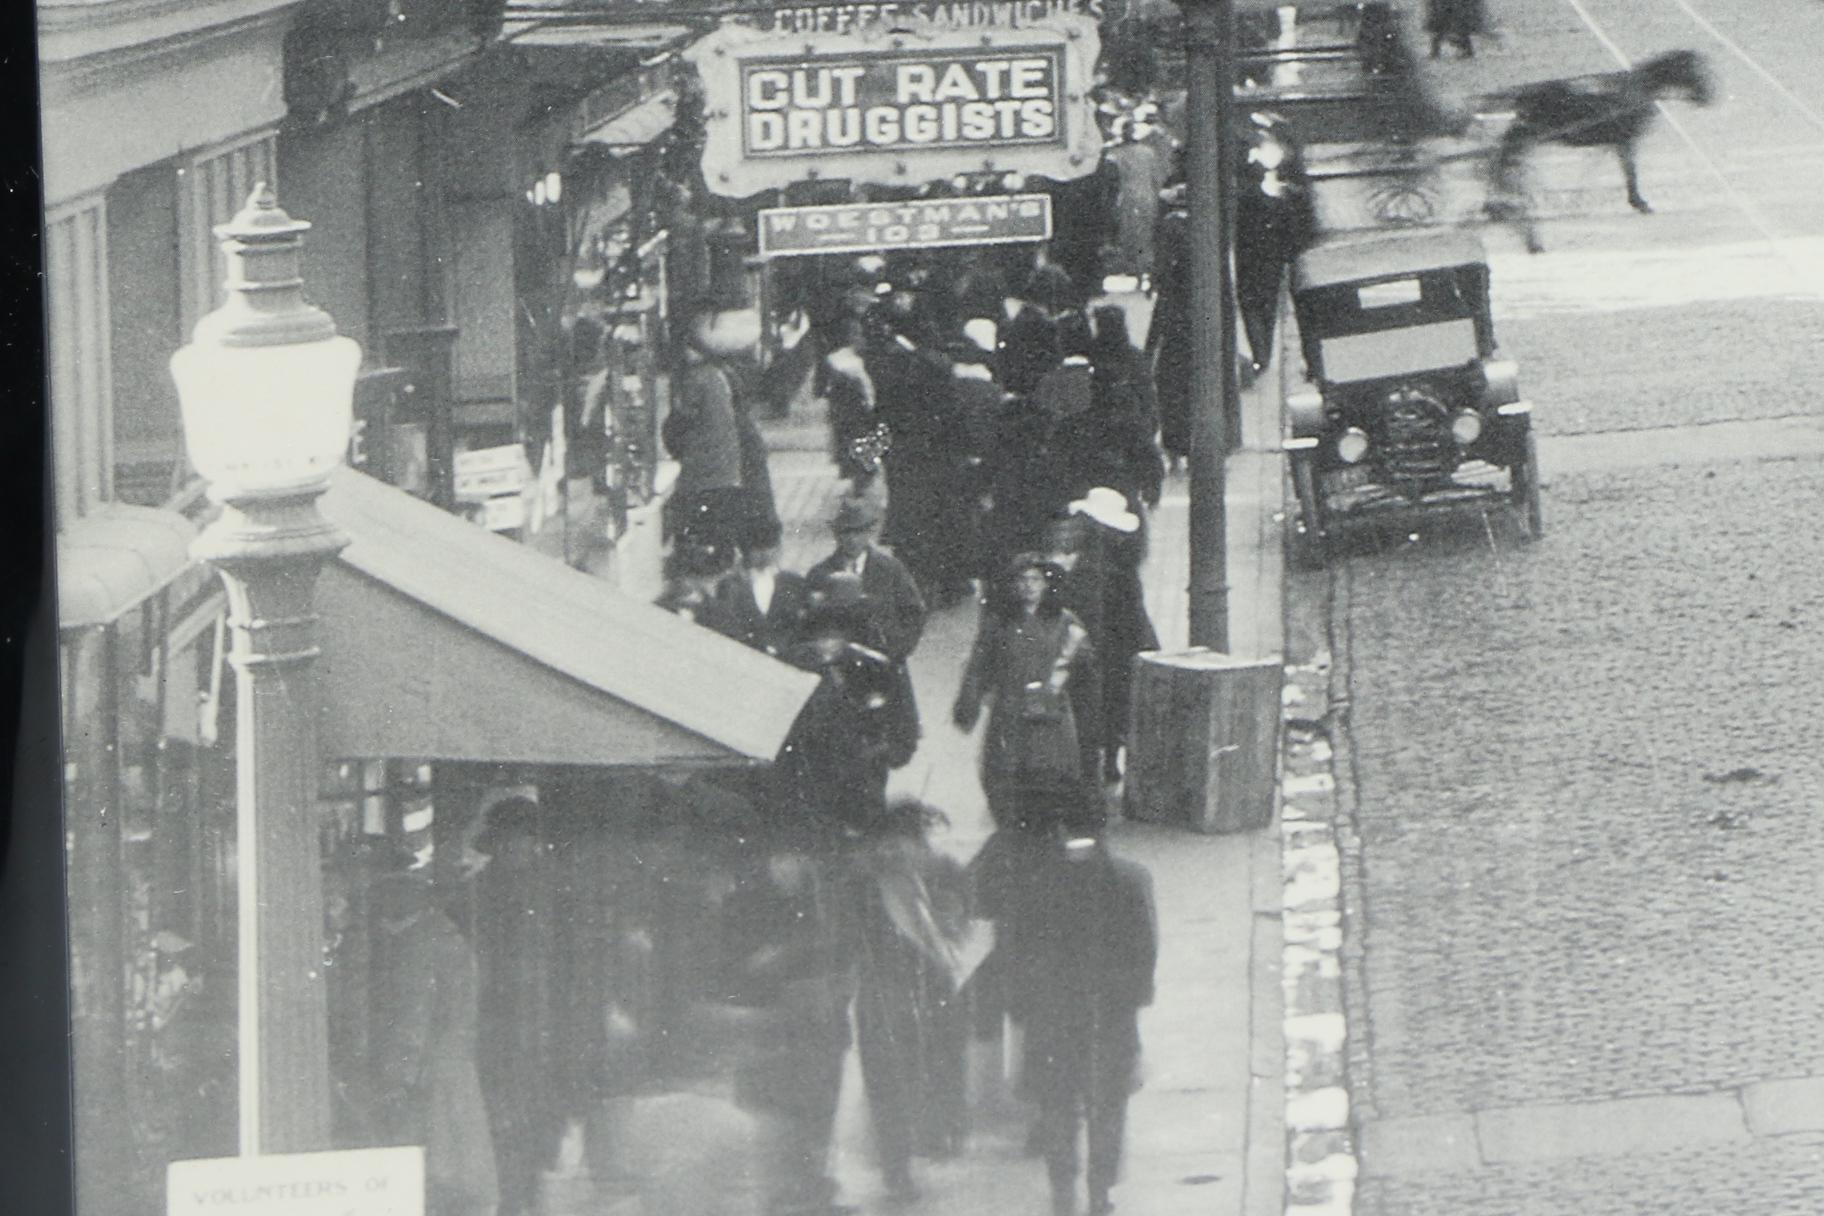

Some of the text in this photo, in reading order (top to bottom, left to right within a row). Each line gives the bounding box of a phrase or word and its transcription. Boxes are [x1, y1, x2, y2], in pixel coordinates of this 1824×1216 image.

[750, 59, 1050, 111] CUT RATE
[750, 99, 1054, 151] DRUGGISTS
